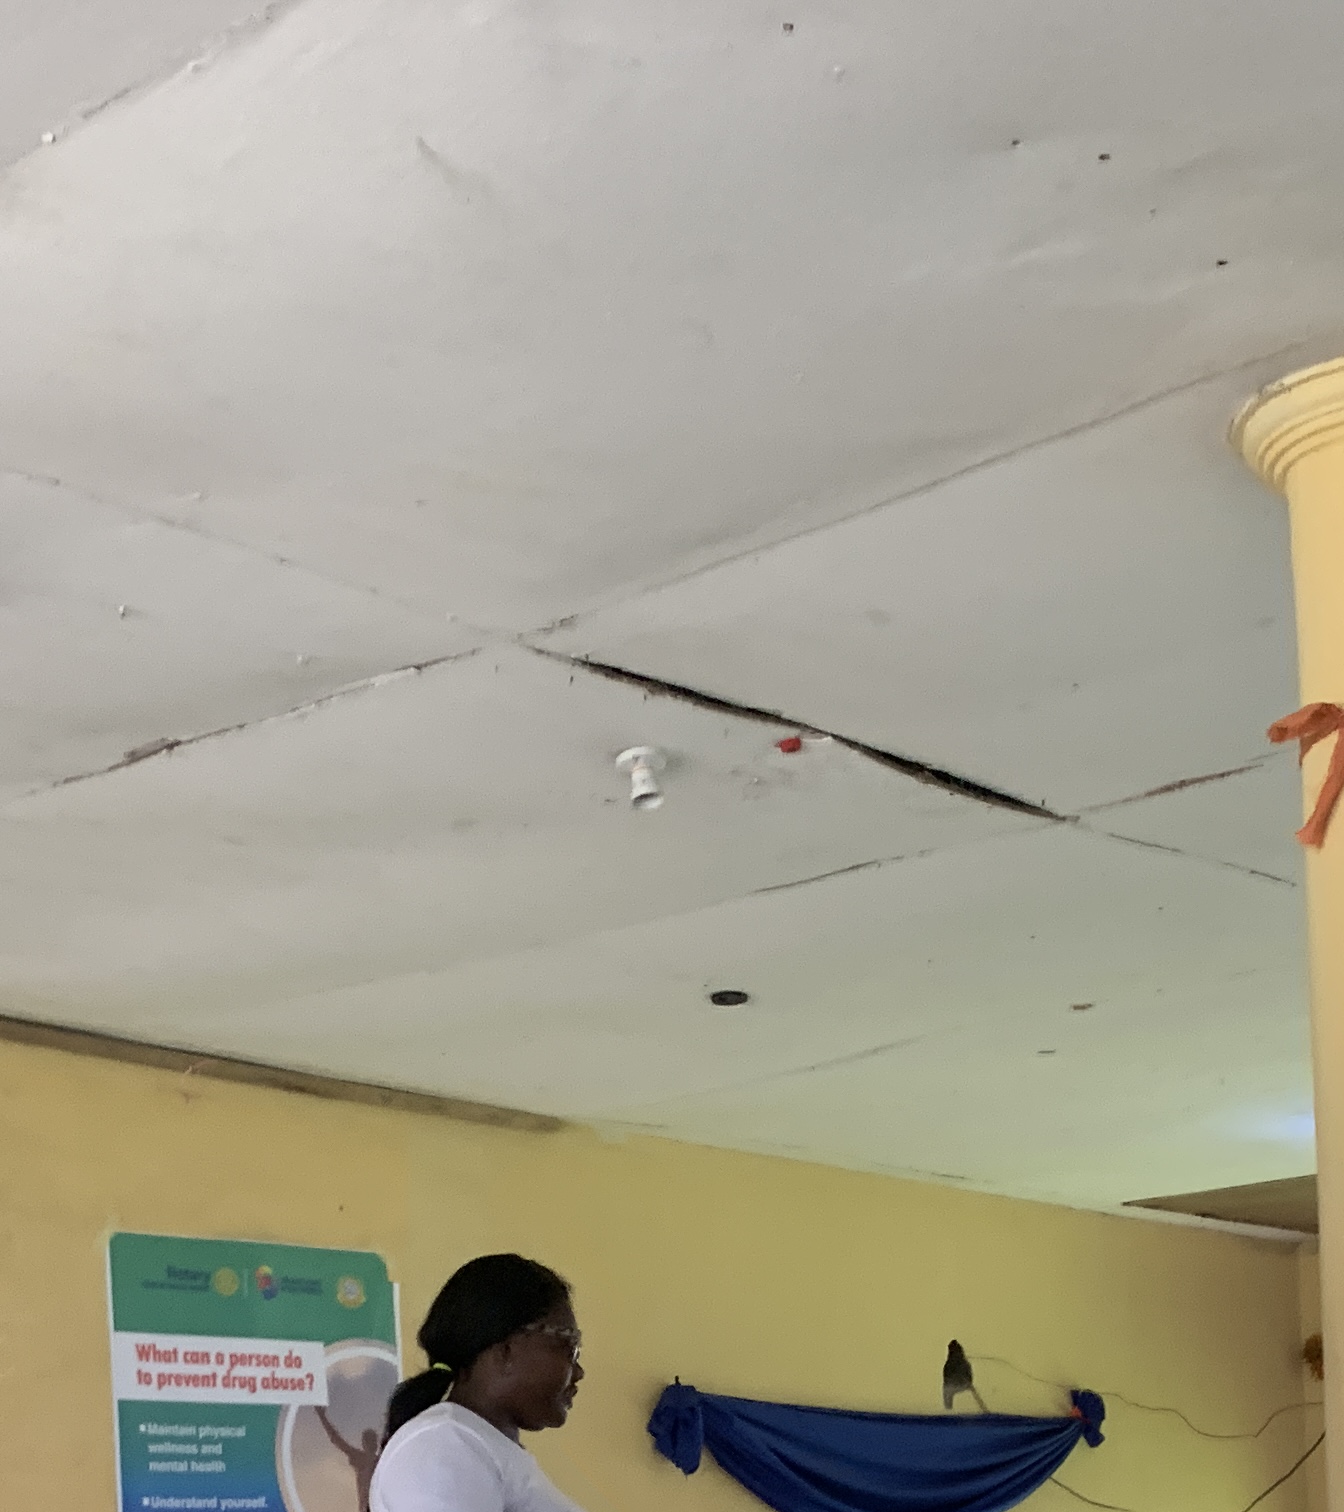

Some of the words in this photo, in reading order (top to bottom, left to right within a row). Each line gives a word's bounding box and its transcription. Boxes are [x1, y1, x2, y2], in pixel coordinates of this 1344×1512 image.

[135, 1344, 178, 1364] What
[183, 1351, 211, 1365] can
[215, 1351, 225, 1366] a
[229, 1352, 280, 1371] person
[284, 1350, 303, 1369] do
[137, 1369, 153, 1386] to
[157, 1371, 217, 1390] prevent
[222, 1368, 257, 1393] drug
[261, 1371, 315, 1391] abuse?
[147, 1423, 197, 1436] Maintain
[198, 1425, 246, 1440] physical
[148, 1442, 198, 1455] wellness
[201, 1442, 222, 1455] and
[149, 1461, 188, 1472] mental
[190, 1460, 226, 1472] health
[151, 1497, 217, 1509] Understand
